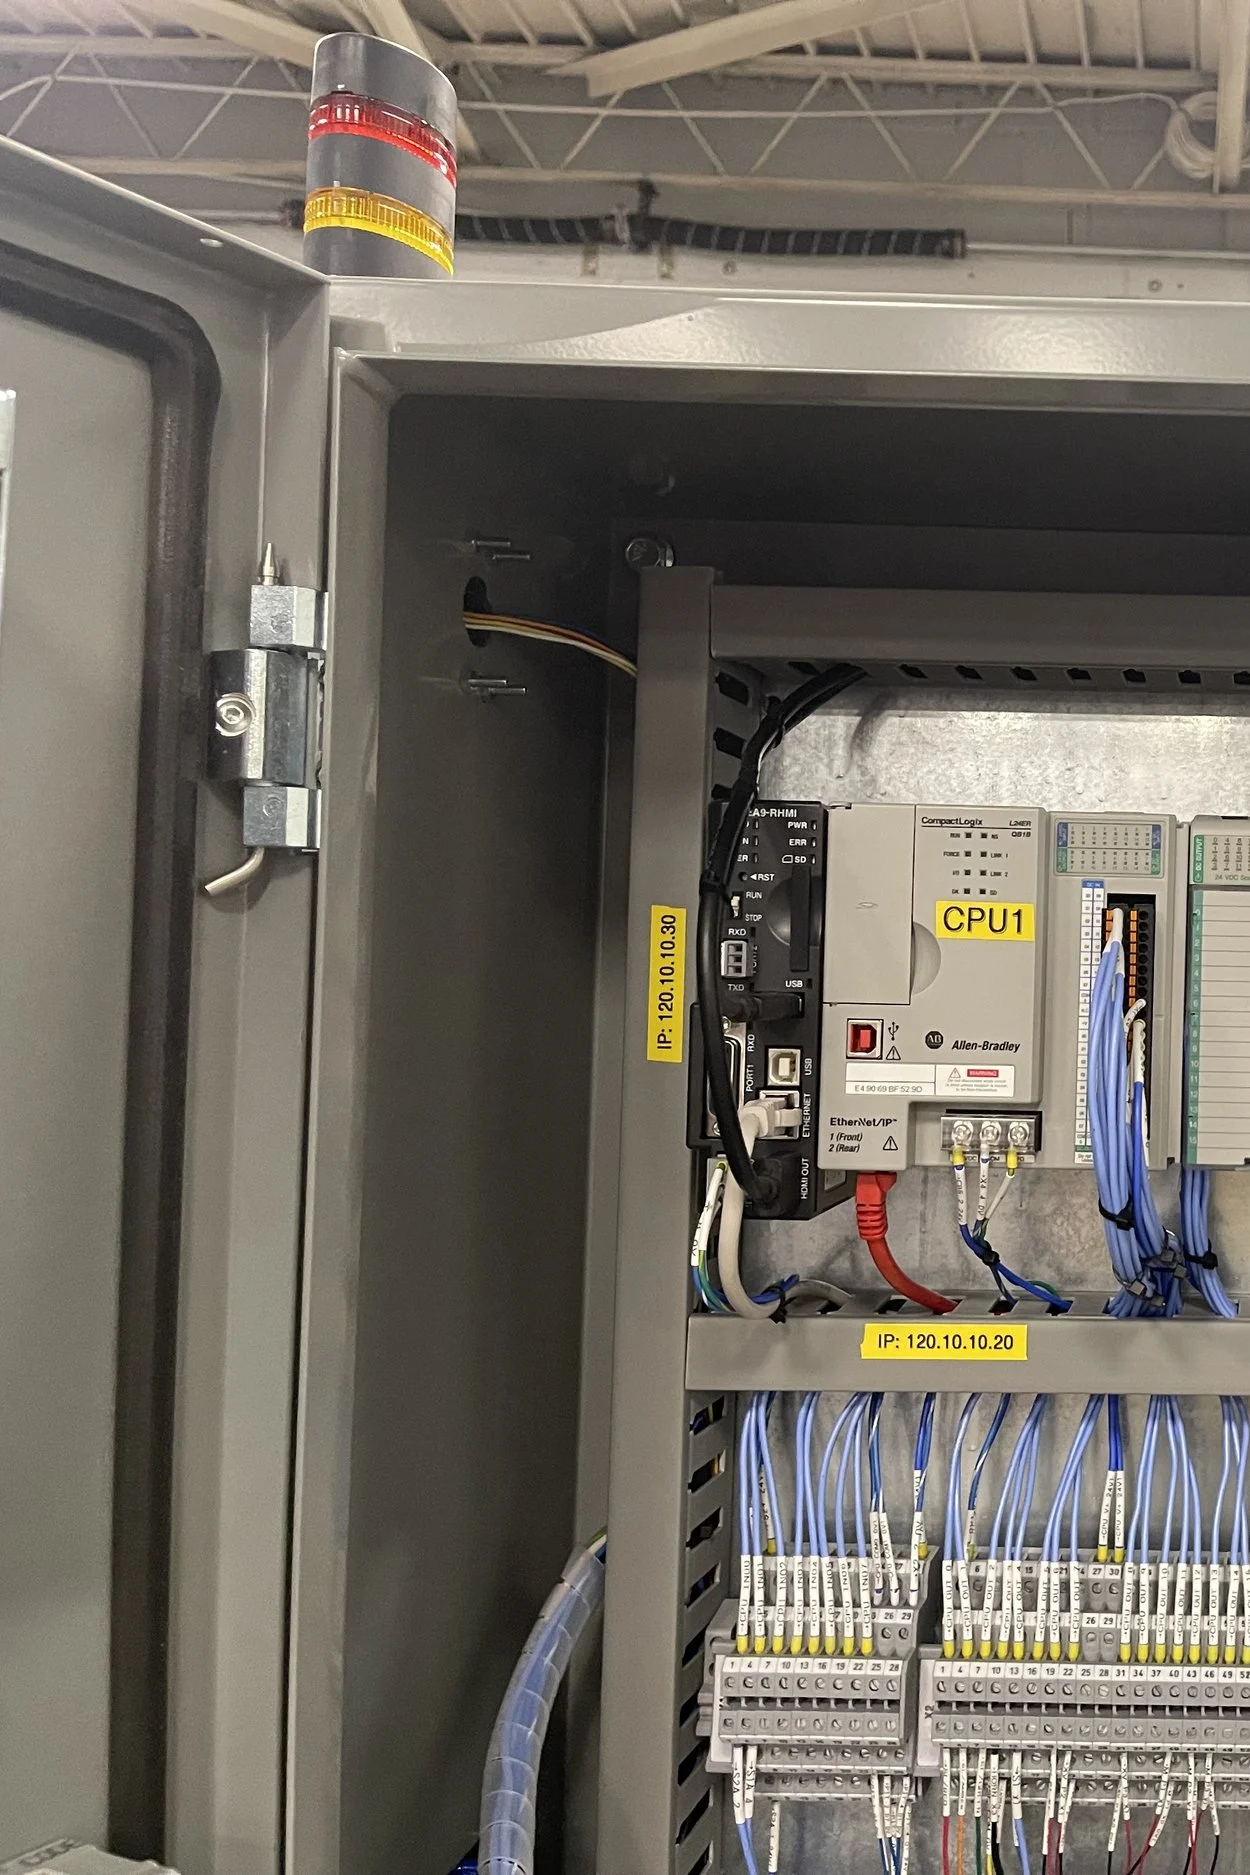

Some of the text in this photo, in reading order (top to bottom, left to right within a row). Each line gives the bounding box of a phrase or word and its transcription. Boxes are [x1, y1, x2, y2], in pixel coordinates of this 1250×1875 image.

[787, 821, 808, 829] PWR
[922, 816, 983, 827] CompactLogix
[1195, 838, 1203, 861] OUTPUT
[794, 856, 807, 864] SD
[757, 873, 775, 881] RST
[745, 891, 762, 899] RUN
[745, 914, 762, 922] STOP
[943, 906, 1022, 934] CPU1
[728, 928, 747, 936] RXD
[657, 914, 677, 1050] IP: 120.10.10.30
[785, 980, 804, 988] USB
[728, 984, 744, 992] TXD
[747, 1033, 755, 1052] RXD
[952, 1040, 1020, 1054] Allen-Bradley
[804, 1058, 812, 1076] USB
[746, 1064, 754, 1092] PORT1
[802, 1093, 812, 1138] ETHERNET
[836, 1133, 863, 1142] (Front)
[836, 1144, 860, 1153] (Rear)
[801, 1158, 810, 1200] HDMI OUT
[878, 1334, 1014, 1350] IP: 120.10.10.20
[901, 1612, 912, 1621] 29
[924, 1705, 934, 1719] X2
